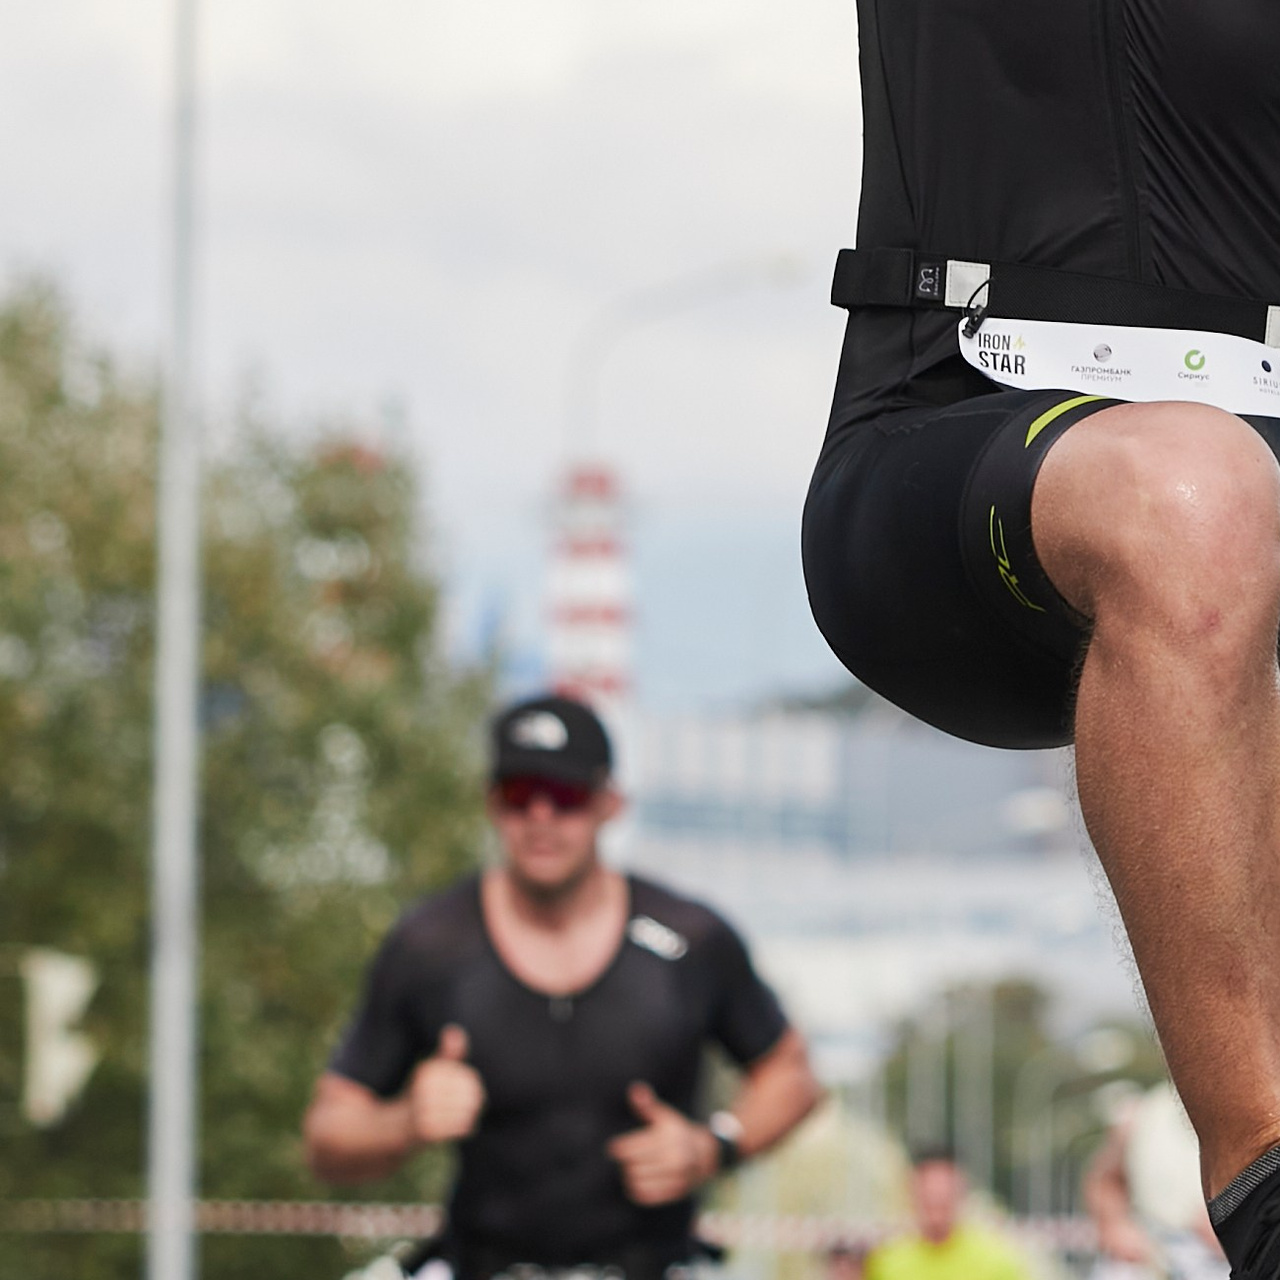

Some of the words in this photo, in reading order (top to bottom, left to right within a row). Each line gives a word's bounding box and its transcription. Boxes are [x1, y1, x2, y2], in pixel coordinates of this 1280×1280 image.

[978, 332, 1011, 351] IRON
[978, 350, 1026, 375] STAR
[1070, 365, 1132, 376] ГАЗПРОМБАНК
[1177, 371, 1210, 381] Сириус
